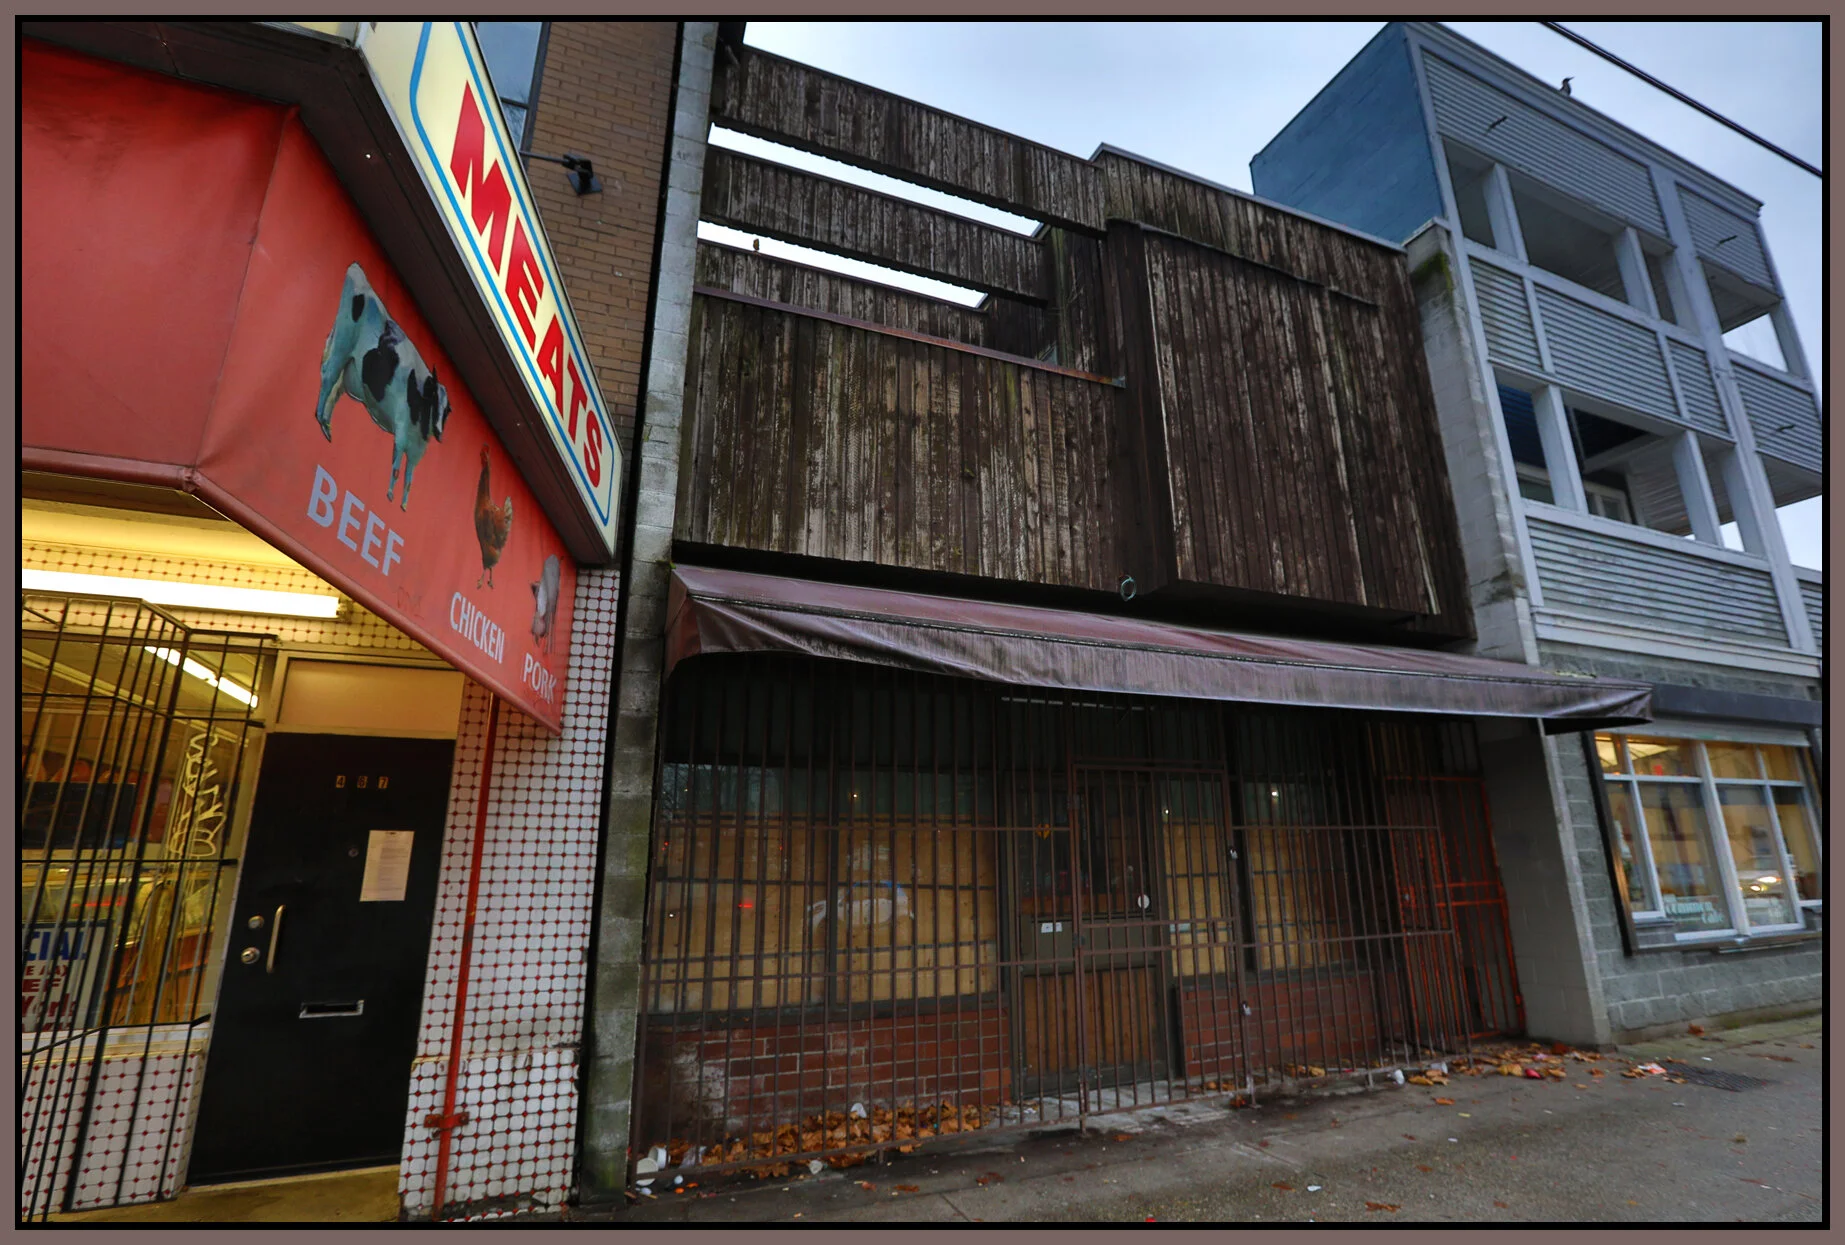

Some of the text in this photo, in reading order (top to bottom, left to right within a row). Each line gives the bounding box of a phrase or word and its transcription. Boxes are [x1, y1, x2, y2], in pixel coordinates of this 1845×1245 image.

[450, 79, 603, 488] MEATS
[307, 463, 405, 577] BEEF
[450, 591, 506, 665] CHICKEN
[522, 652, 558, 705] PORK
